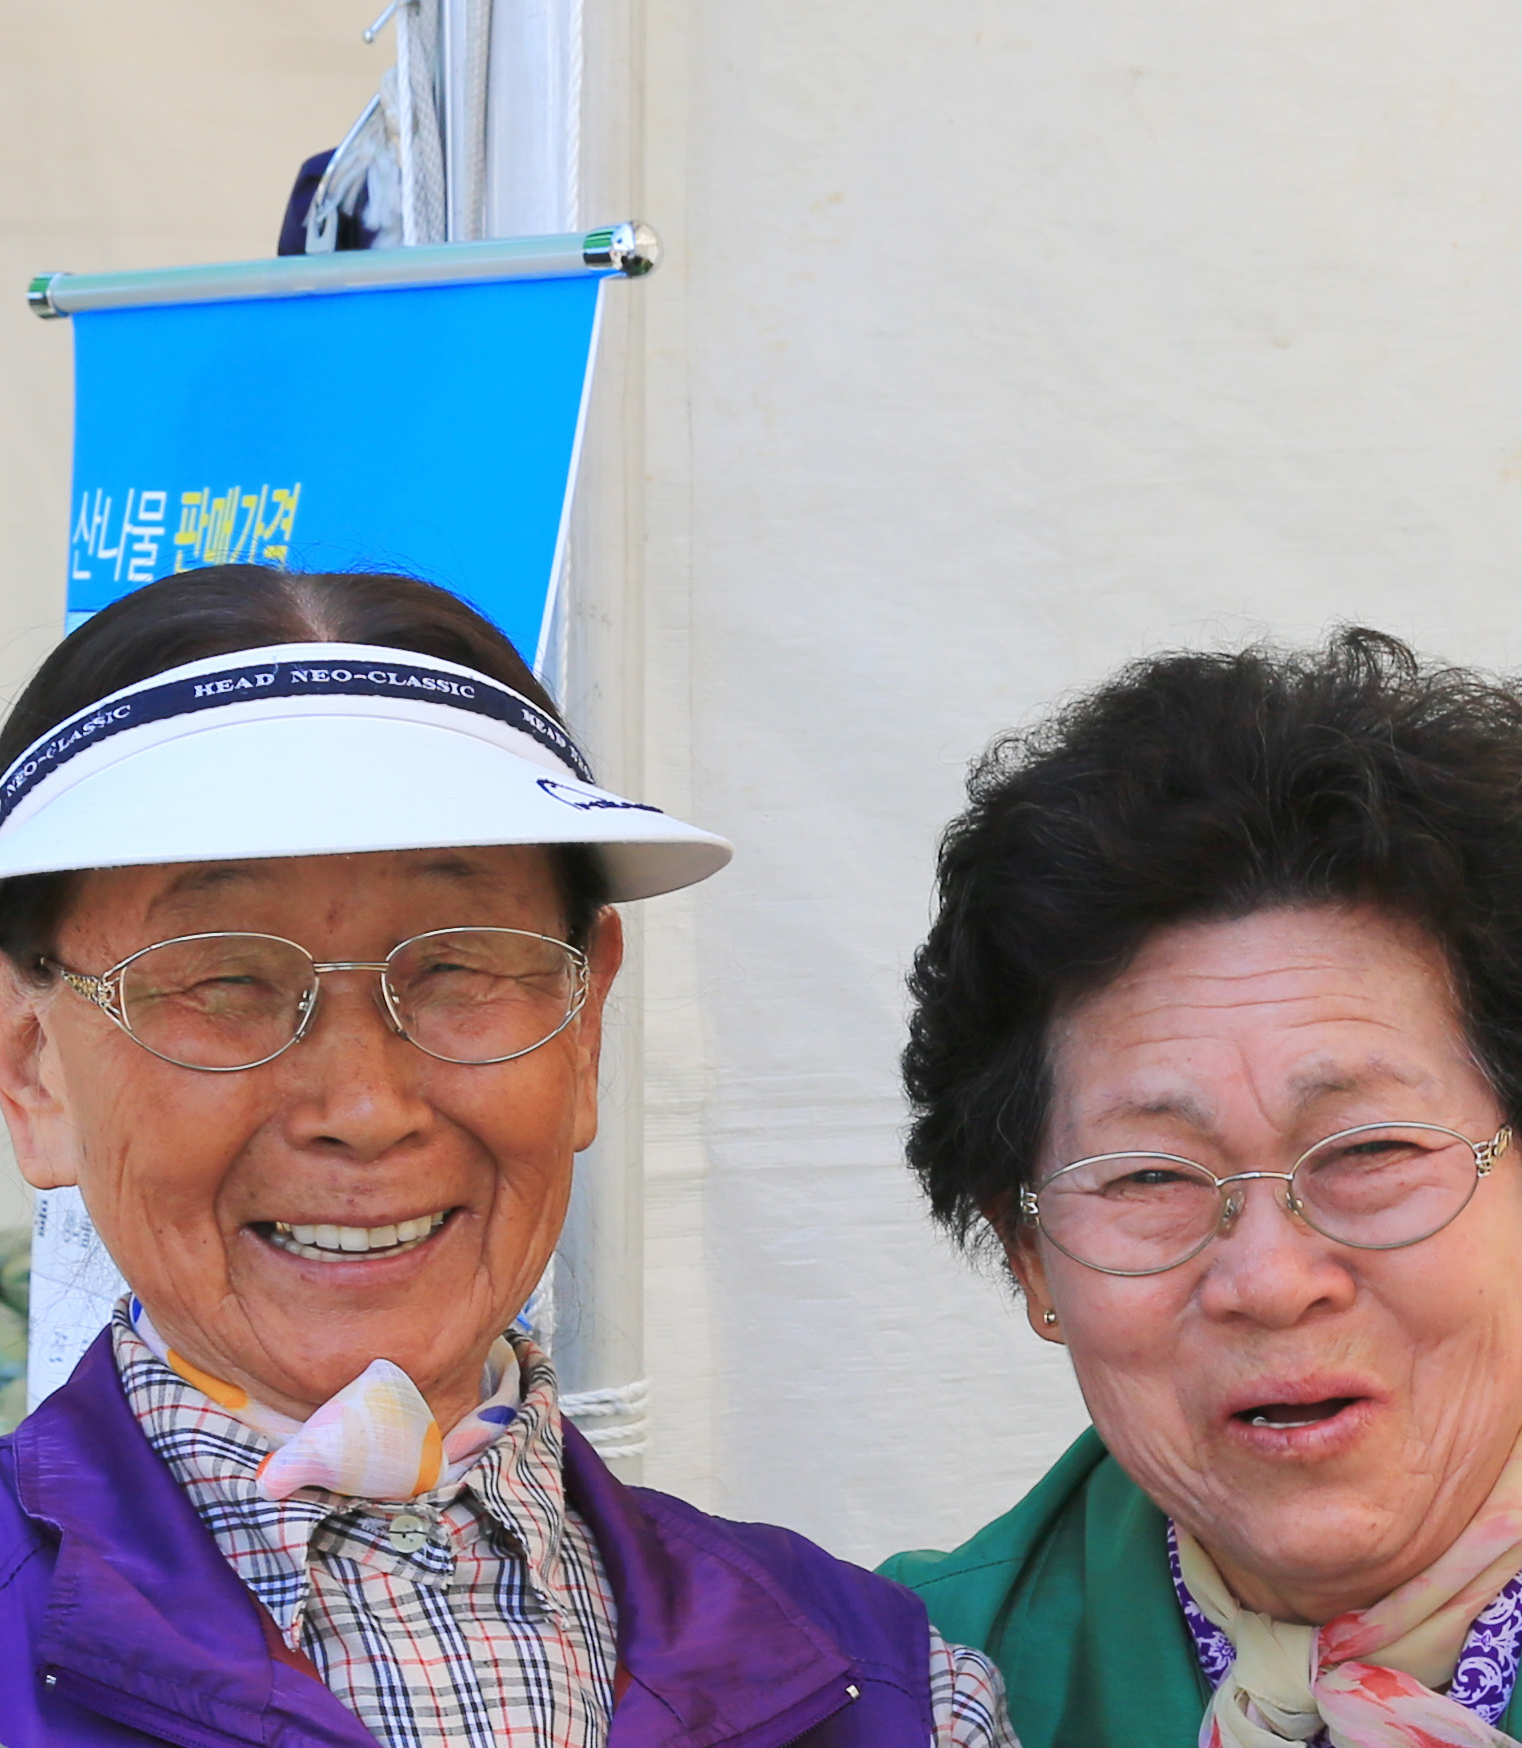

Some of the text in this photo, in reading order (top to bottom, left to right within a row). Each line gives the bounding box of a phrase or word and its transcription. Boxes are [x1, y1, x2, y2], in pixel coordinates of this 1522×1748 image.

[72, 482, 301, 582] 산나물 판매가격
[192, 669, 475, 698] HEAD NEO-CLASSIC
[6, 704, 131, 797] NEO-CLASSIC
[521, 708, 567, 748] HEAD
